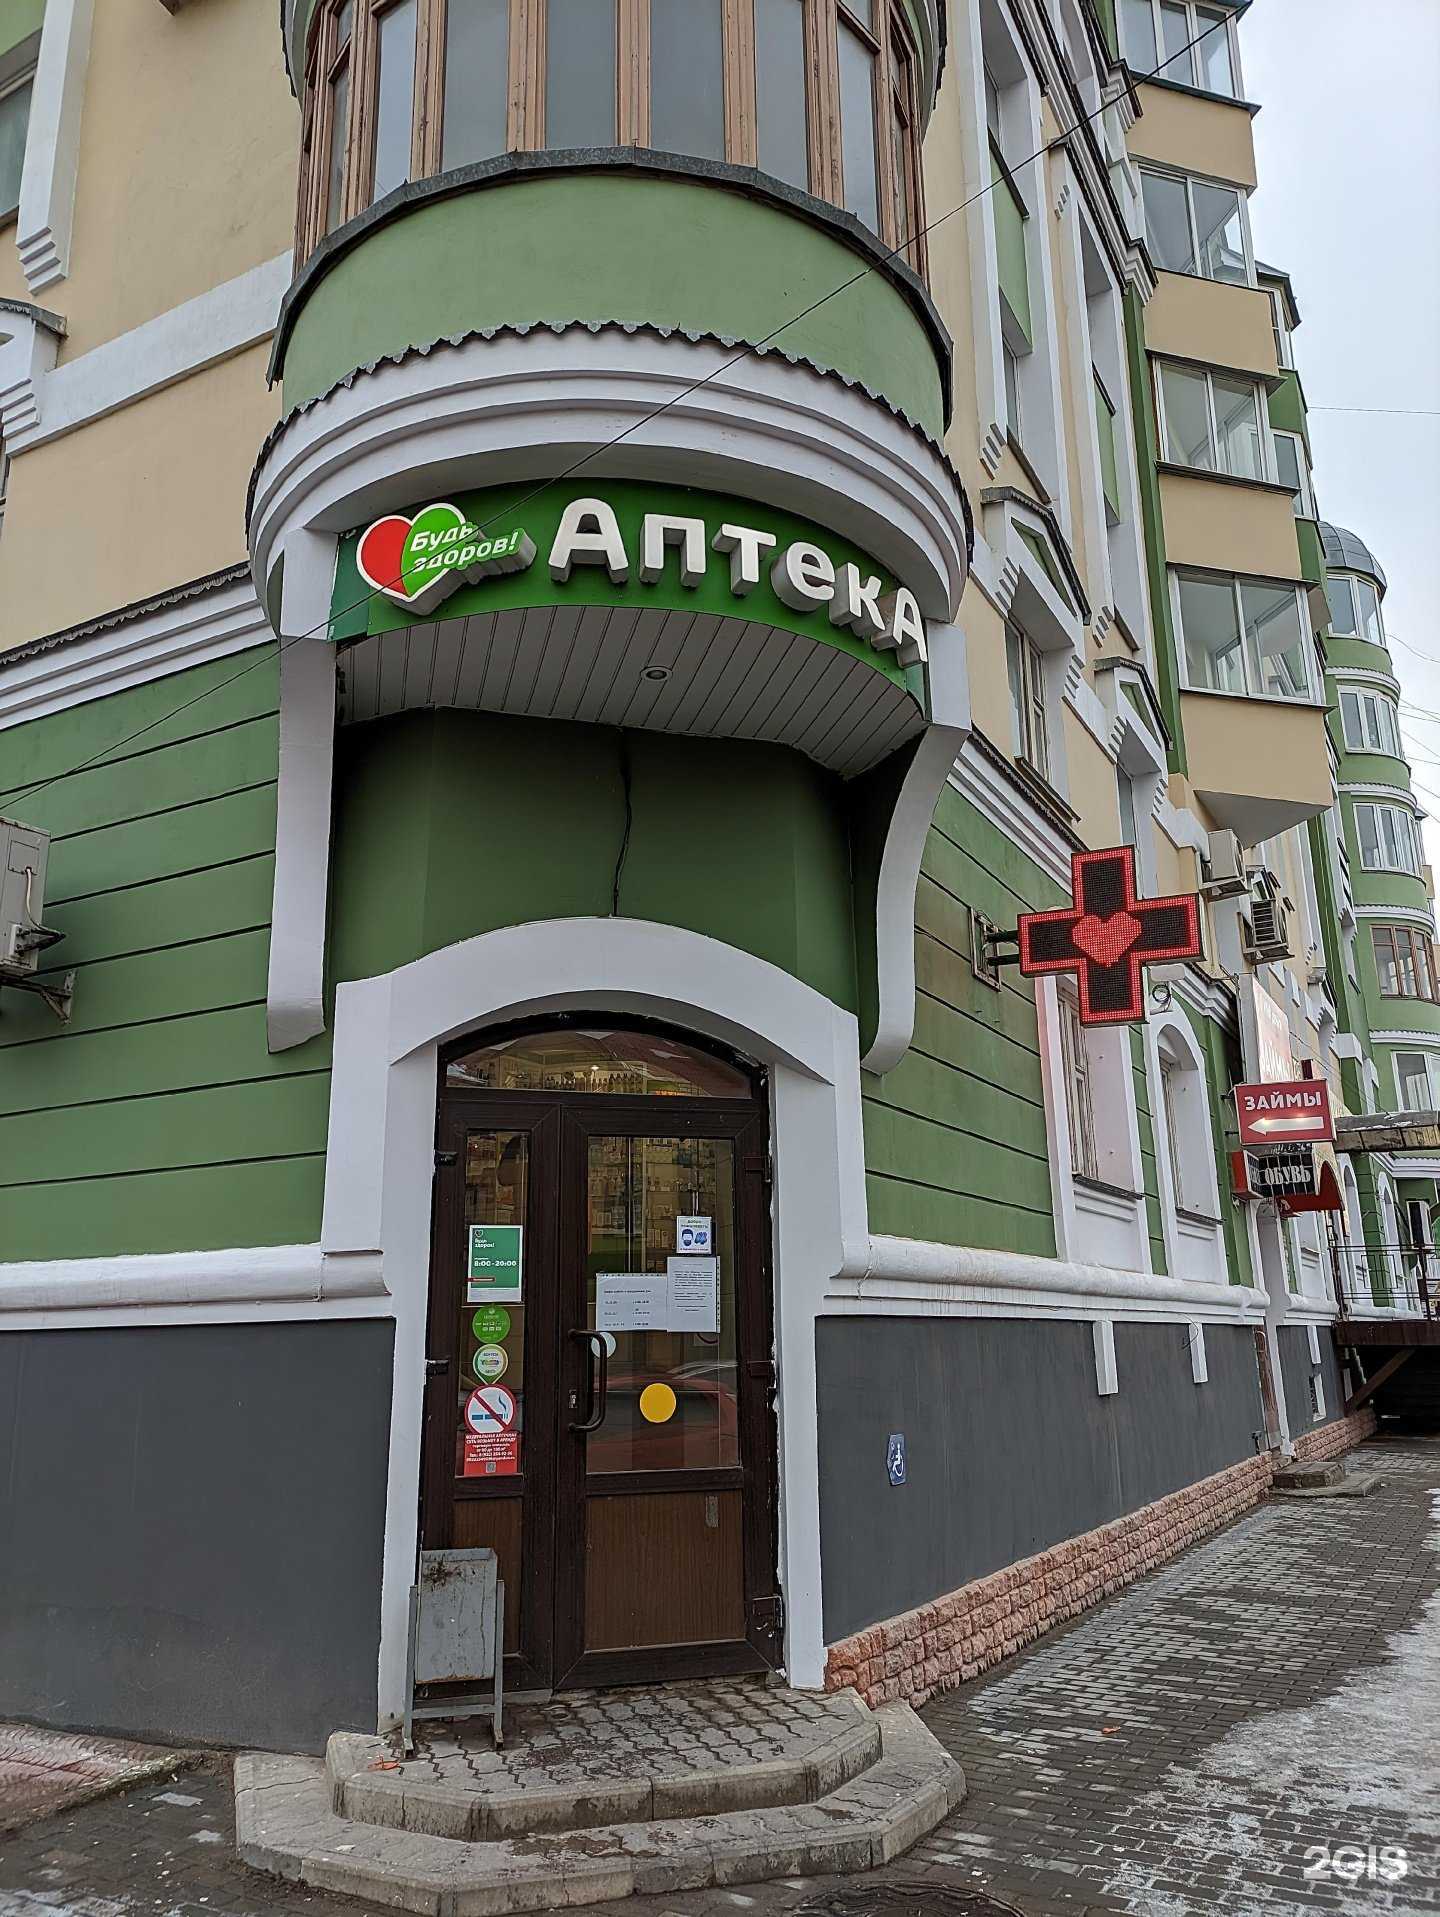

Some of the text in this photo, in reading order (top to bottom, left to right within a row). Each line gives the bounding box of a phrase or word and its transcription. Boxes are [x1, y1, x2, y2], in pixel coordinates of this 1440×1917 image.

[410, 525, 473, 552] Будь
[413, 531, 519, 573] здоров!
[1245, 1091, 1322, 1111] ЗАЙМЫ
[1264, 1165, 1312, 1186] ОБУВЬ
